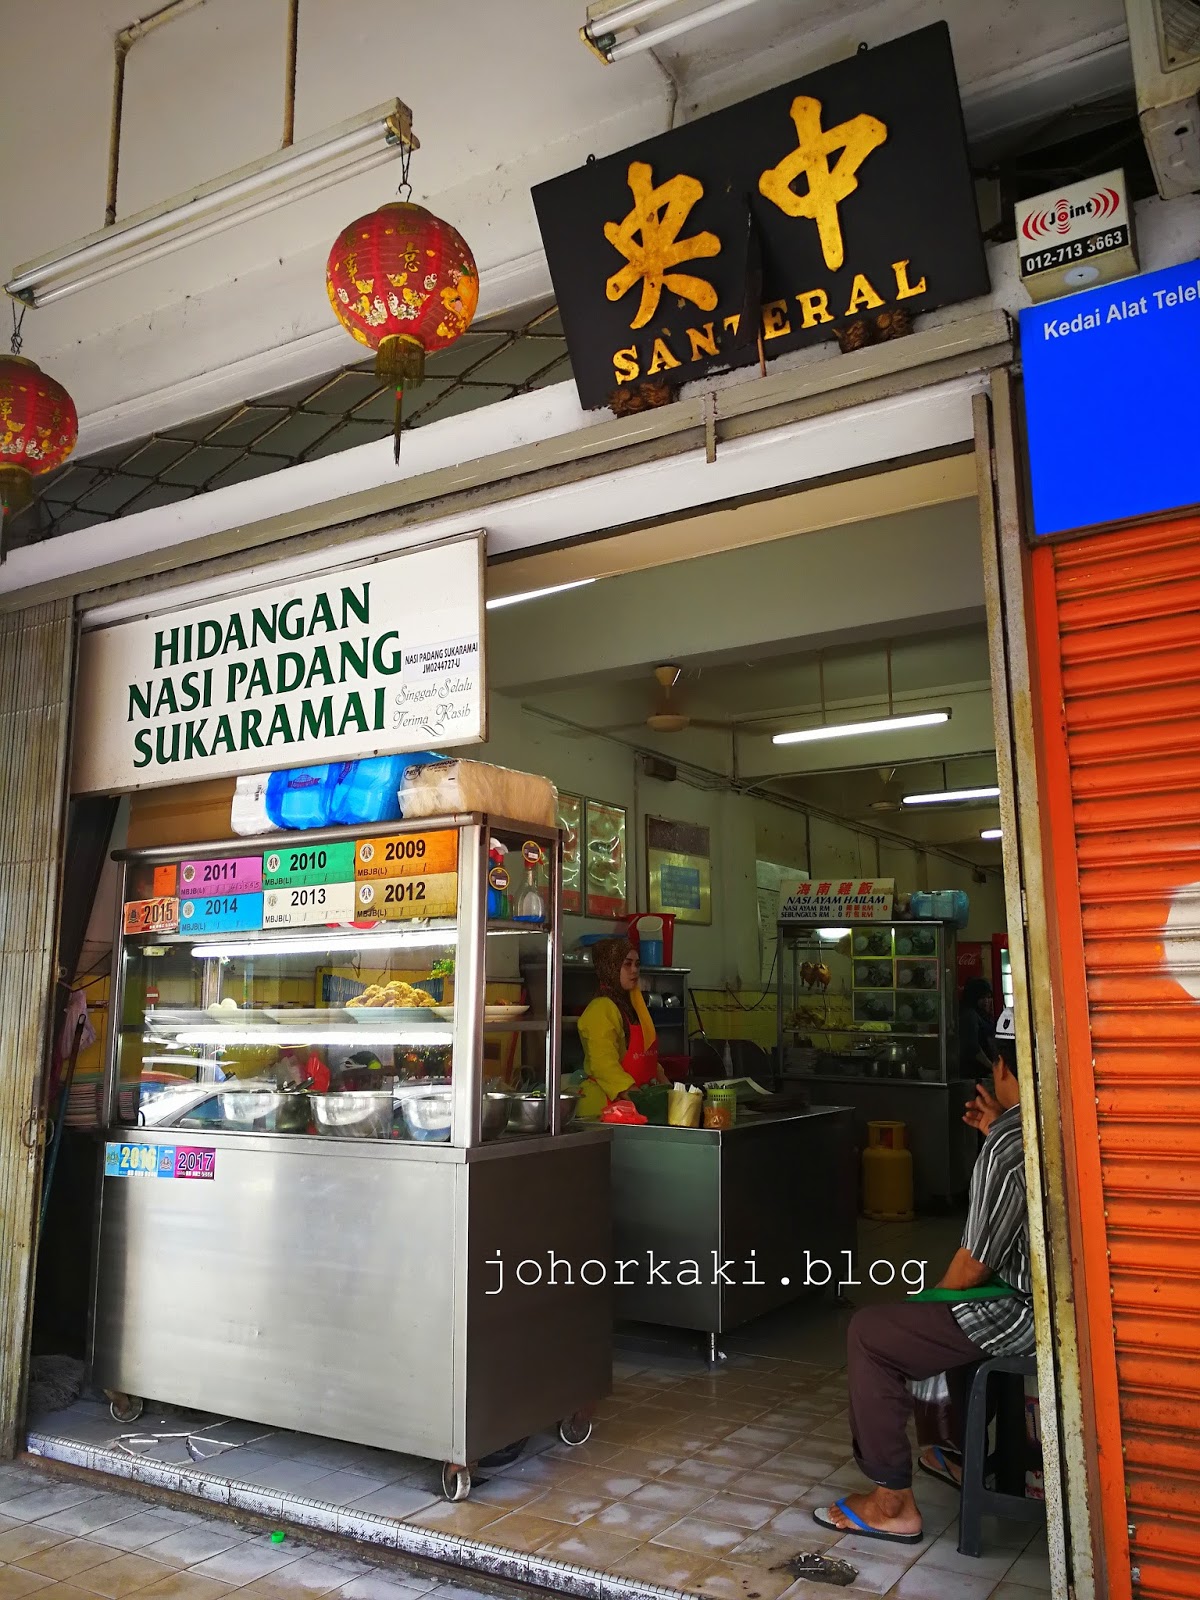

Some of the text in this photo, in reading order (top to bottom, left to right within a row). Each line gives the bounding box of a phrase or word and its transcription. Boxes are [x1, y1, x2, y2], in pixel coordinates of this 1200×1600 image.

[1049, 201, 1093, 226] Joint
[1026, 243, 1083, 272] 012-713
[1044, 280, 1200, 340] Kedai Alat Tele
[155, 582, 370, 669] HIDANGAN
[405, 641, 478, 665] NASI PADANG SUKARAMAI
[128, 631, 402, 722] NASI PADANG
[134, 687, 387, 768] SUKARAMAI
[393, 710, 429, 729] Terima
[385, 840, 426, 860] 2009
[290, 851, 327, 871] 2010
[203, 862, 238, 881] 2011
[265, 876, 292, 886] MBJB(L)
[357, 867, 388, 877] MBJB(L)
[291, 889, 326, 906] 2013
[384, 882, 426, 902] 2012
[813, 896, 840, 904] AYAM
[844, 896, 885, 904] HAILAM
[144, 902, 173, 923] 2015
[205, 898, 238, 915] 2014
[121, 1146, 157, 1171] 2016
[178, 1152, 215, 1171] 2017
